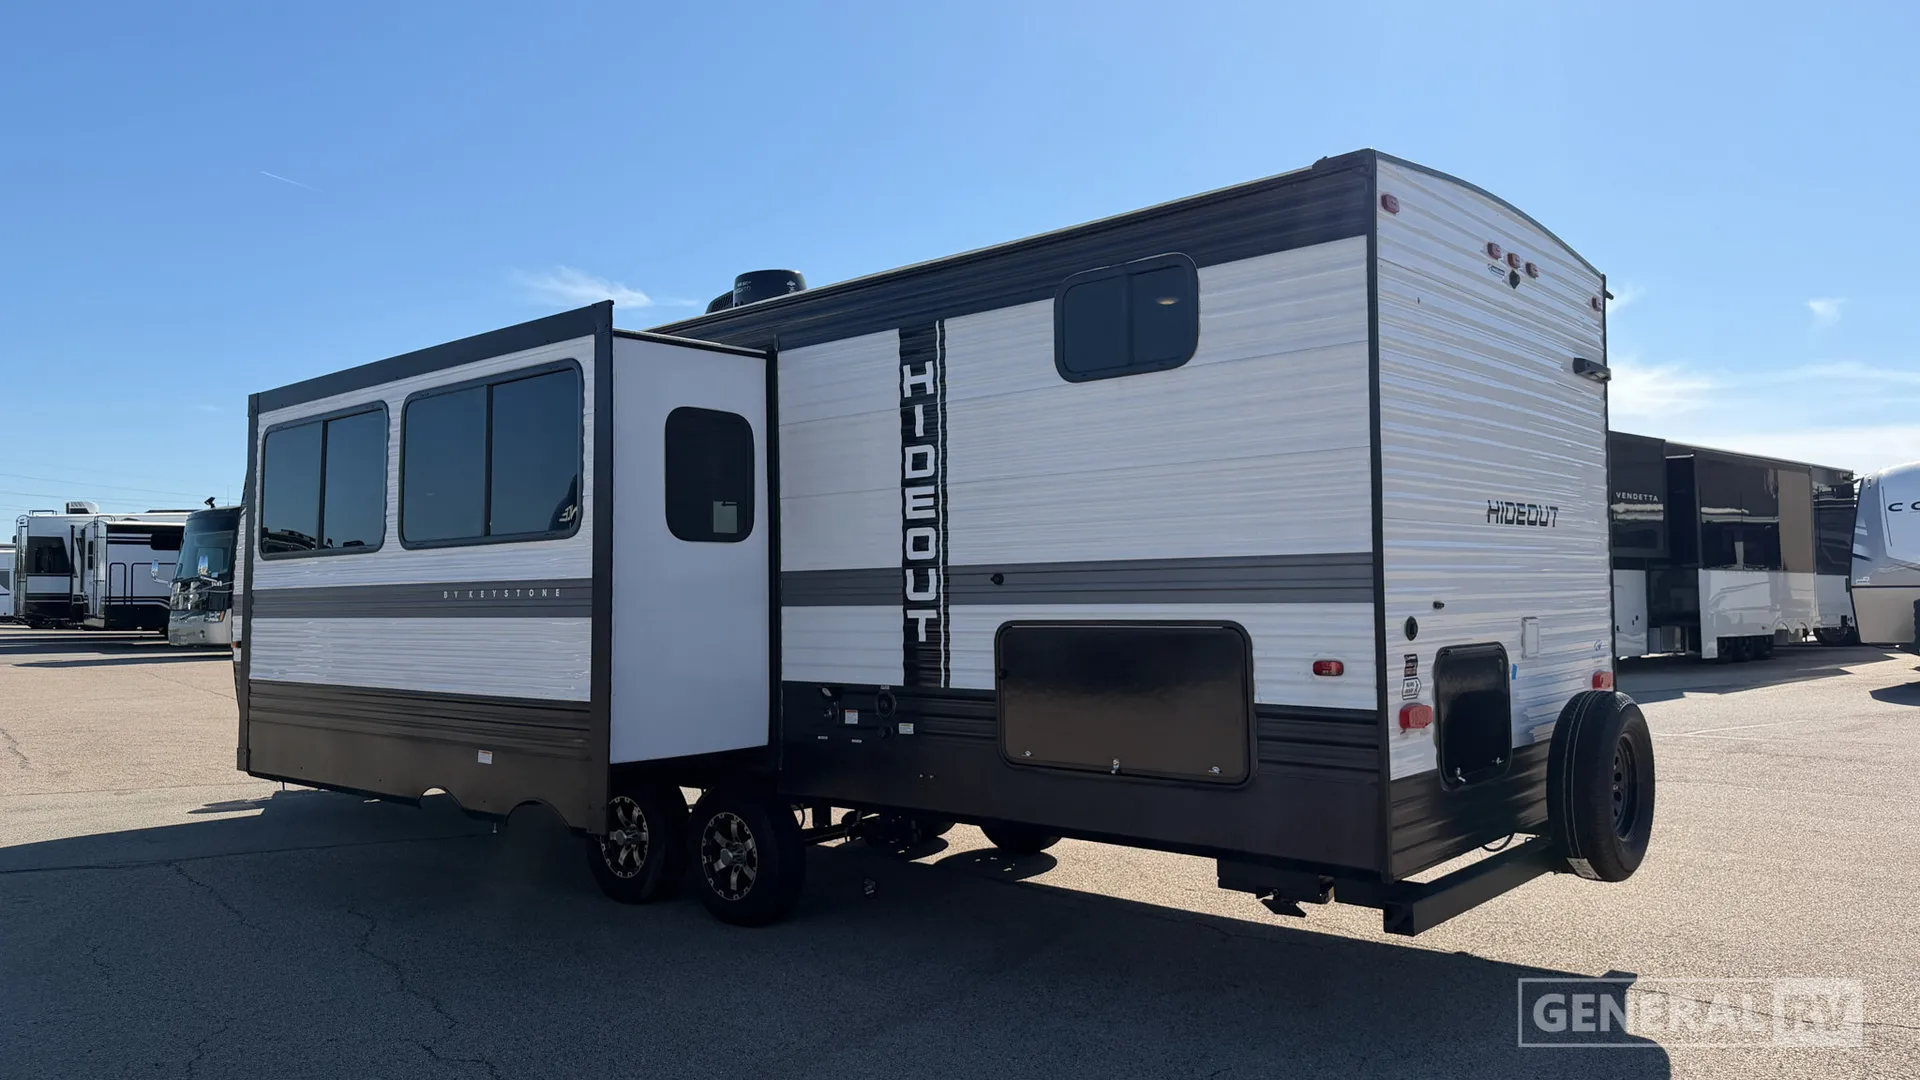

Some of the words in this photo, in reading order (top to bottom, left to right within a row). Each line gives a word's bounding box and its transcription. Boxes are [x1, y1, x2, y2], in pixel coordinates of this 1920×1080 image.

[902, 360, 938, 642] HIDEOUT
[1615, 491, 1659, 502] VENDETTA
[1487, 499, 1559, 528] HIDEOUT
[443, 590, 459, 599] BY
[468, 588, 560, 599] KEYSTONE
